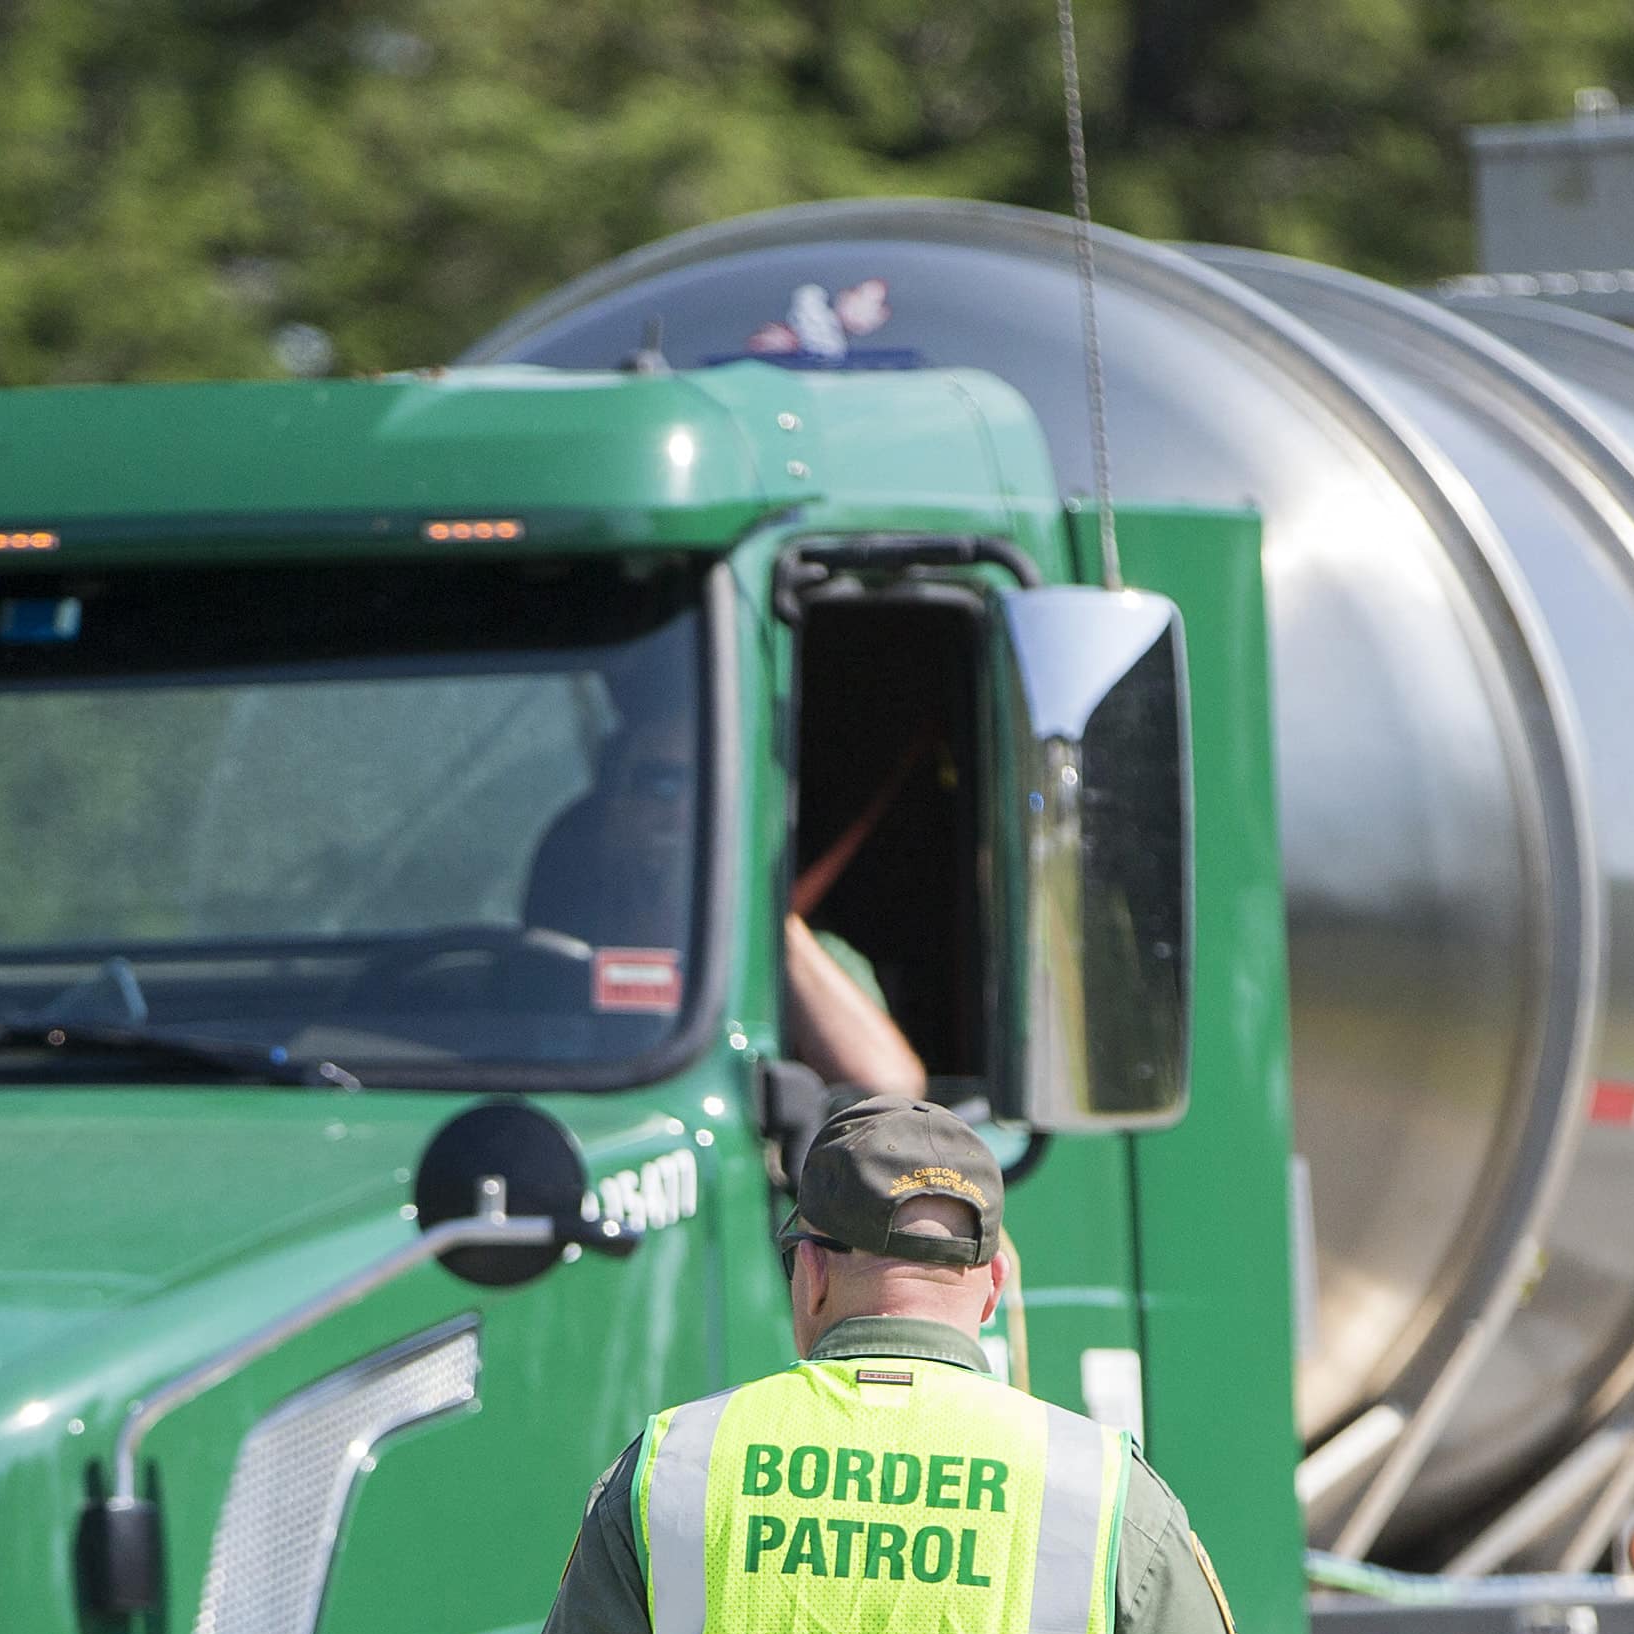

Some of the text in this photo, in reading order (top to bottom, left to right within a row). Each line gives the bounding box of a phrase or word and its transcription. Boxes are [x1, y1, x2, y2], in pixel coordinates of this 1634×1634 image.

[890, 1178, 928, 1196] BORDER
[914, 1167, 962, 1182] CUSTOMS
[963, 1179, 983, 1196] AND
[742, 1444, 1009, 1513] BORDER
[744, 1515, 991, 1587] PATROL
